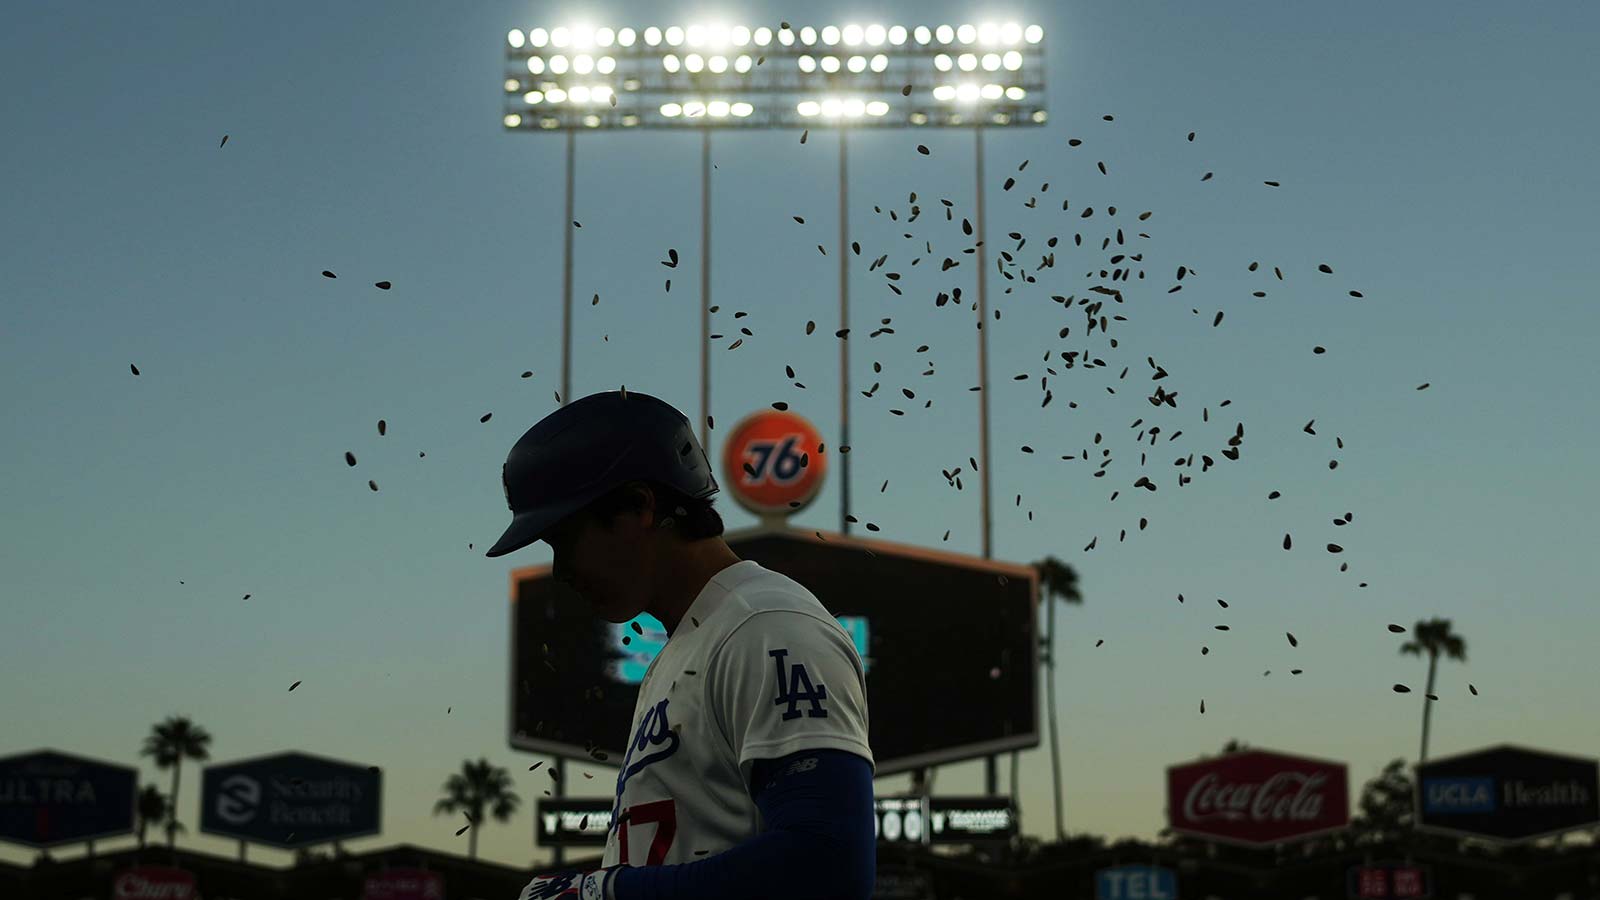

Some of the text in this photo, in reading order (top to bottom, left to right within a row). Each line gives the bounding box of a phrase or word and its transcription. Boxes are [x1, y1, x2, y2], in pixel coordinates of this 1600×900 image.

[743, 434, 804, 485] 76
[769, 649, 827, 720] LA
[1428, 778, 1588, 808] UCLA Health
[619, 800, 676, 866] 17
